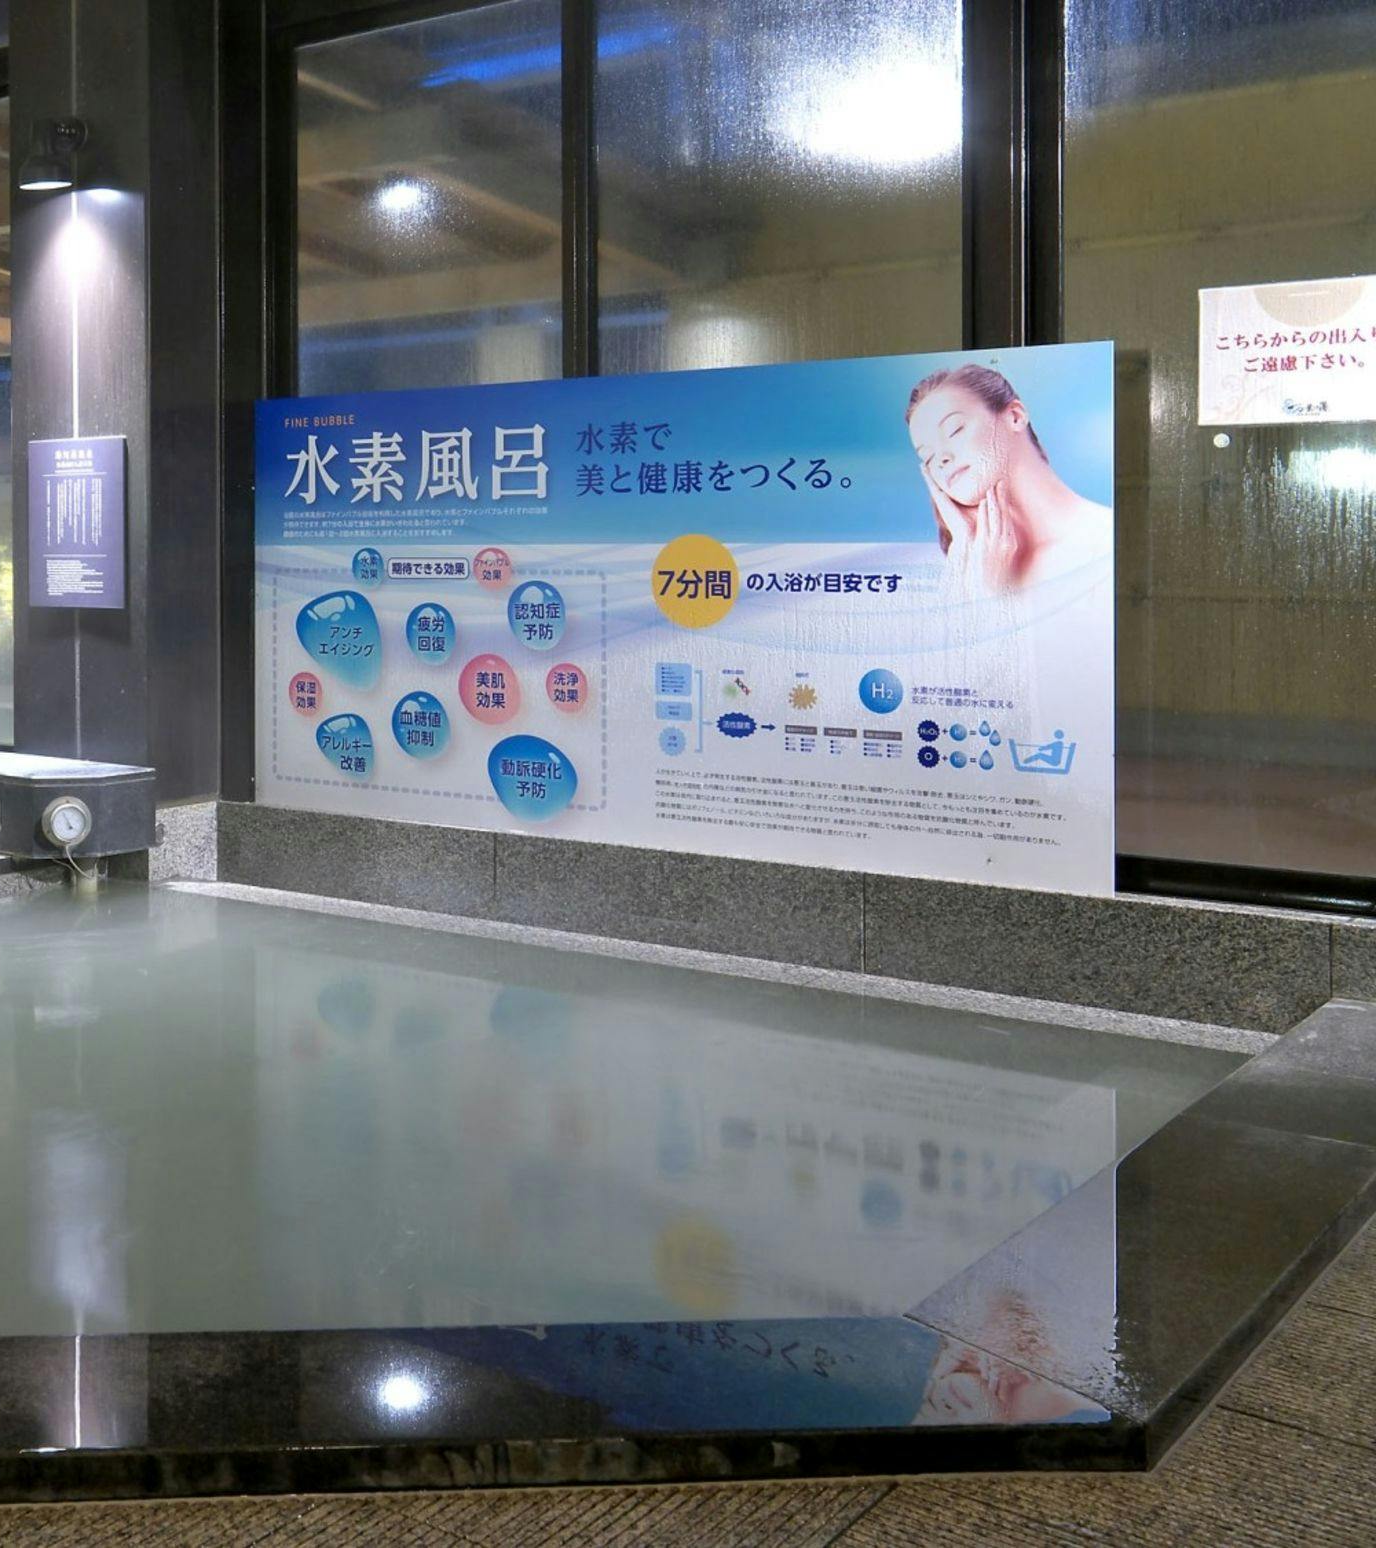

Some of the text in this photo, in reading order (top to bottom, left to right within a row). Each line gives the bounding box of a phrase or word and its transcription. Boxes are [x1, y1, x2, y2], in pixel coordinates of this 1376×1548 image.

[1244, 353, 1365, 373] ご遠慮下さい。
[284, 414, 355, 428] FINE BUBBLE
[575, 421, 672, 454] 水素で
[284, 423, 549, 504] 水素風呂
[575, 456, 852, 497] 美と健康をつくる。
[360, 568, 379, 580] 効果
[391, 562, 466, 576] 期待できる効果
[482, 569, 502, 581] 効果
[657, 568, 733, 600] 7分間
[746, 572, 902, 594] の入浴が目安です
[514, 603, 561, 620] 認知症
[330, 626, 363, 639] アンチ
[417, 616, 445, 632] 疲労
[523, 624, 554, 641] 予防
[318, 642, 374, 656] エイジング
[417, 636, 446, 652] 回復
[296, 680, 316, 694] 保温
[476, 672, 505, 689] 美肌
[554, 672, 579, 687] 洗浄
[296, 696, 316, 710] 効果
[476, 692, 506, 709] 効果
[554, 688, 579, 704] 効果
[400, 710, 442, 728] 血糖値
[322, 735, 372, 752] アレルギー
[406, 730, 435, 748] 抑制
[340, 756, 366, 773] 改善
[501, 758, 562, 780] 動脈硬化
[516, 781, 546, 800] 予防
